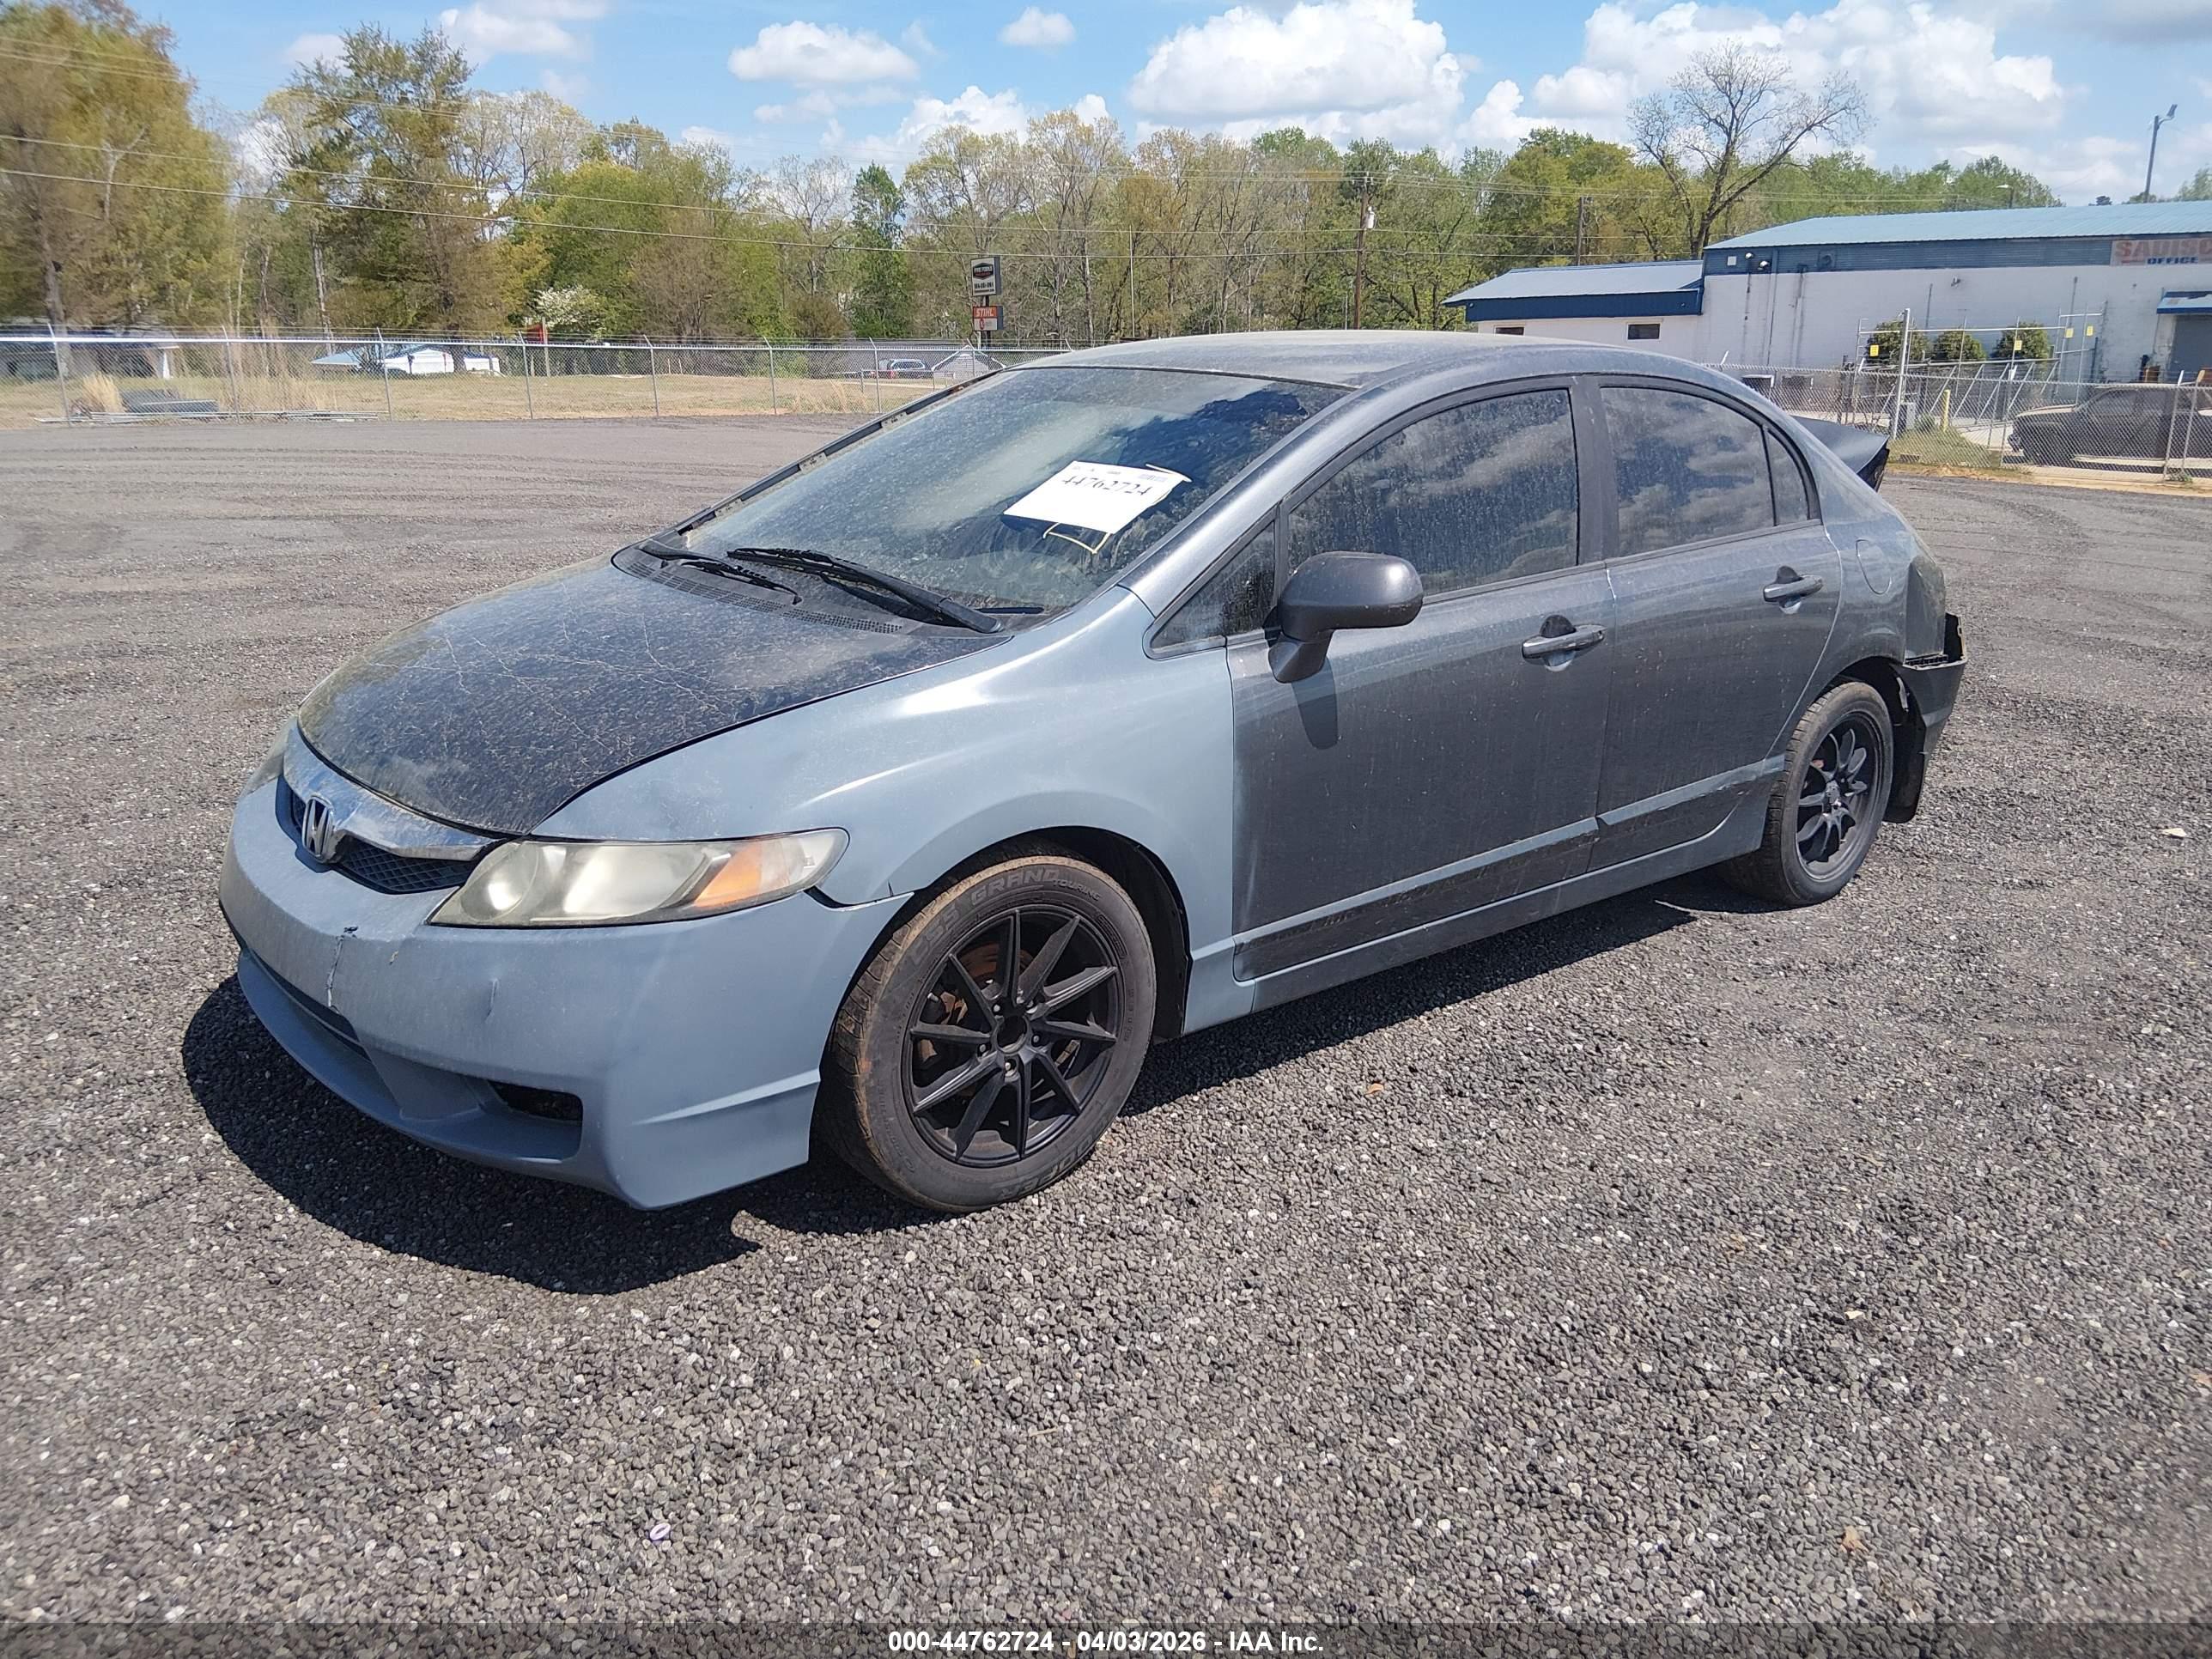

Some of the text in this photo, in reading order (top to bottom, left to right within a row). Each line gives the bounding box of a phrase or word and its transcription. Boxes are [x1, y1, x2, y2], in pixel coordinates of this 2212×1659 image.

[975, 308, 994, 317] STIHL
[1062, 475, 1153, 496] 44762724
[971, 868, 1059, 906] GRAND
[1052, 878, 1103, 902] TOURING
